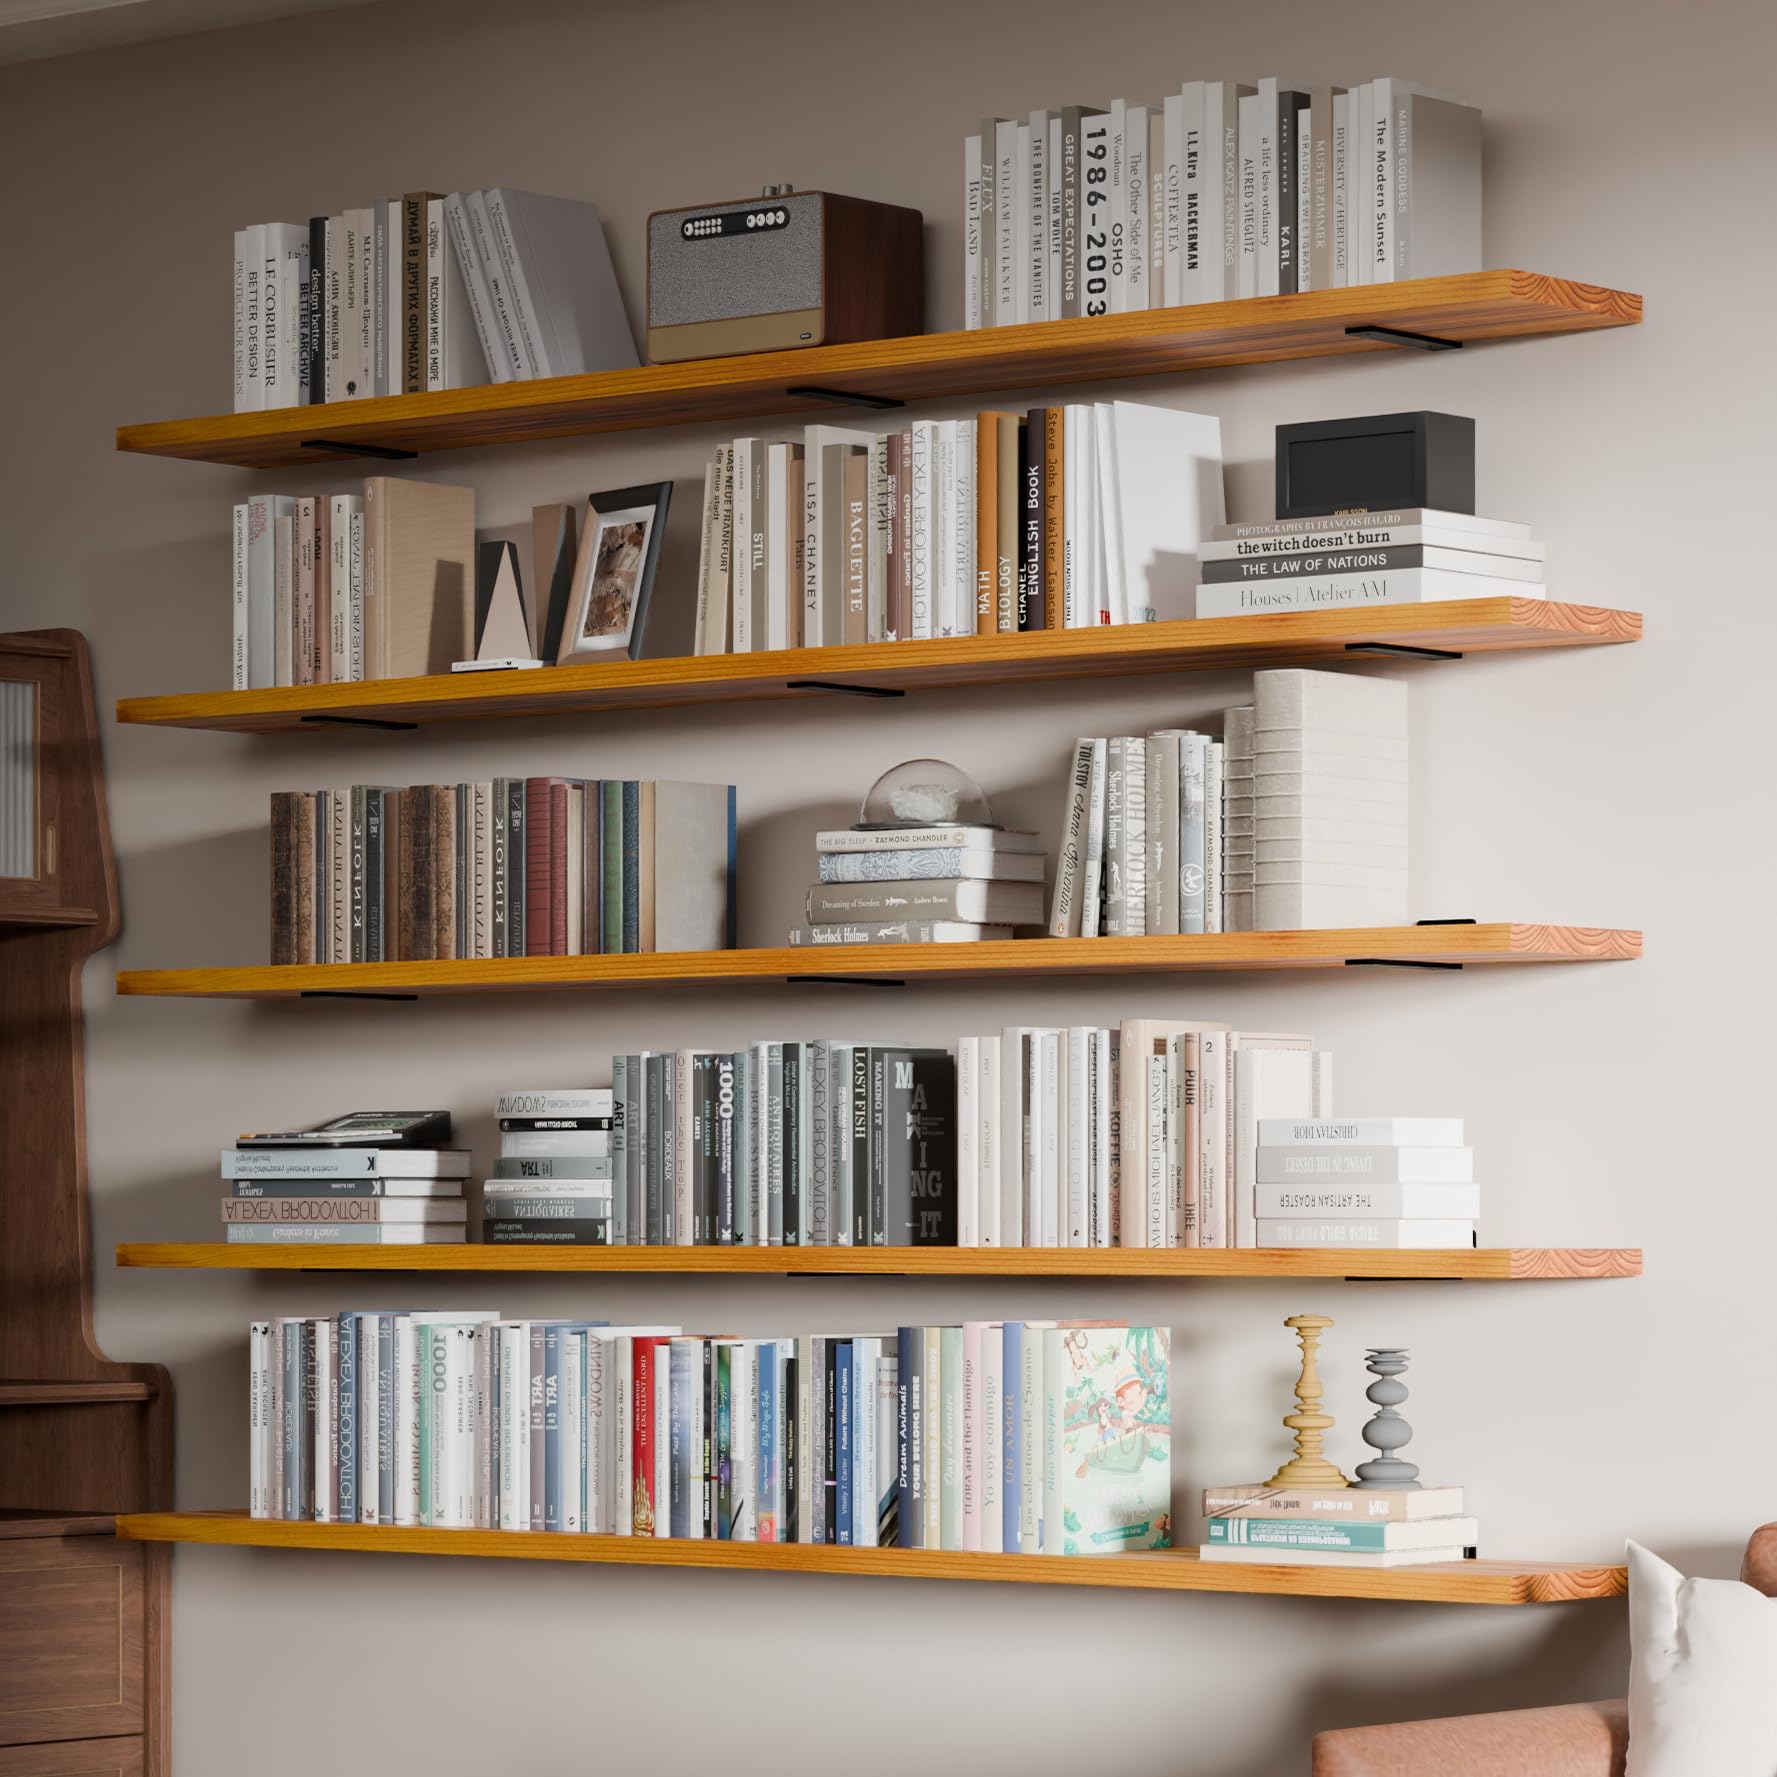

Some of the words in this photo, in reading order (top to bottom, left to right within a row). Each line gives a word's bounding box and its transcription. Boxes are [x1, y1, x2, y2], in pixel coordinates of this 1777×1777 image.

[1032, 138, 1042, 158] THE
[1225, 127, 1234, 159] ALEX
[1376, 117, 1387, 146] The
[1065, 133, 1074, 183] GREAT
[1113, 133, 1122, 187] Woodman
[1130, 152, 1142, 175] The
[1225, 162, 1234, 193] KATZ
[1244, 158, 1254, 198] ALFRED
[1336, 127, 1345, 191] DIVERSITY
[1376, 150, 1387, 207] Modern
[982, 163, 993, 213] FLUX
[1001, 157, 1010, 220] WILLIAM
[1032, 163, 1042, 209] BONFIRE
[1052, 190, 1060, 214] TOM
[1130, 179, 1142, 215] Other
[1315, 140, 1325, 248] MUSTERZIMMER
[1336, 195, 1345, 206] of
[1032, 215, 1042, 227] OF
[1052, 219, 1060, 255] WOLFE
[1086, 128, 1107, 317] 1986-2003
[1130, 219, 1142, 245] Side
[1153, 172, 1163, 268] SCULPTURES
[1225, 197, 1234, 266] PAINTINGS
[1244, 202, 1254, 254] STIEGLITZ
[1336, 210, 1345, 271] HERITAGE
[1376, 212, 1387, 263] Sunset
[1032, 232, 1042, 252] THE
[1065, 188, 1074, 301] EXPECTATIONS
[1112, 222, 1124, 276] OSHO
[1130, 248, 1142, 261] of
[1281, 226, 1290, 270] KARL
[265, 257, 276, 280] LE
[1001, 227, 1010, 304] FAULKNER
[1032, 257, 1042, 307] VANITIES
[1130, 265, 1142, 283] Me
[248, 271, 258, 321] BETTER
[300, 282, 309, 328] BETTER
[310, 269, 321, 310] design
[429, 276, 438, 324] РАССКАЖИ
[248, 325, 258, 378] DESIGN
[265, 284, 276, 388] CORBUSIER
[310, 313, 321, 361] better...
[429, 327, 438, 346] МНЕ
[300, 332, 309, 389] ARCHVIZ
[429, 359, 438, 382] МОРЕ
[1048, 412, 1057, 450] Steve
[715, 449, 724, 464] die
[726, 449, 734, 473] DAS
[1048, 458, 1057, 486] Jobs
[713, 467, 721, 493] neue
[724, 476, 733, 505] NEUE
[712, 495, 721, 521] stadt
[807, 482, 816, 524] LISA
[1048, 495, 1057, 509] by
[719, 509, 731, 574] FRANKFURT
[1048, 517, 1057, 562] Walter
[1237, 521, 1303, 536] PHOTOGRAPHS
[1304, 520, 1316, 531] BY
[1317, 517, 1361, 531] FRANÇOIS
[1363, 513, 1401, 525] HALARD
[1237, 541, 1260, 554] the
[1262, 537, 1301, 553] witch
[1302, 533, 1354, 550] doesn't
[1357, 530, 1391, 544] burn
[753, 532, 764, 571] STILL
[849, 500, 863, 613] BAGUETTE
[1027, 519, 1039, 596] ENGLISH
[1241, 562, 1268, 577] THE
[1273, 560, 1300, 573] LAW
[1304, 558, 1322, 571] OF
[1327, 552, 1387, 569] NATIONS
[807, 534, 816, 611] CHANEY
[978, 570, 991, 614] MATH
[999, 556, 1011, 630] BIOLOGY
[1240, 588, 1292, 607] Houses
[1305, 584, 1356, 603] Atelier
[1360, 579, 1387, 598] AM
[1018, 563, 1026, 624] CHANEL
[1048, 570, 1057, 630] Isaacson
[1075, 745, 1093, 789] TOLSTOY
[1109, 771, 1121, 811] Sherlock
[1070, 793, 1085, 837] Anna
[1109, 815, 1121, 849] Holmes
[875, 834, 910, 844] RAYMOND
[912, 833, 948, 843] CHANDLER
[1059, 843, 1079, 915] Karenina
[812, 929, 842, 944] Sherlock
[843, 927, 869, 942] Holmes
[1204, 1042, 1213, 1052] 2
[720, 1061, 733, 1119] 1000
[813, 1045, 826, 1113] ALEXEY
[855, 1051, 866, 1096] LOST
[874, 1061, 882, 1110] MAKING
[1185, 1069, 1195, 1105] PUUR
[614, 1100, 624, 1130] ART
[628, 1100, 639, 1130] ART
[855, 1100, 866, 1139] FISH
[874, 1113, 882, 1126] IT
[1293, 1125, 1314, 1139] DIOR
[1316, 1125, 1358, 1139] CHRISTIAN
[664, 1130, 672, 1180] BORDEAUX
[772, 1096, 781, 1194] ANTIQUAIRES
[1110, 1110, 1120, 1168] KOFFIE
[813, 1118, 826, 1232] BRODOVITCH
[1185, 1201, 1195, 1230] THEE
[1279, 1194, 1316, 1207] ROASTER
[1318, 1194, 1353, 1207] ARTISAN
[1356, 1194, 1372, 1207] THE
[1023, 1348, 1034, 1407] Susana
[899, 1385, 908, 1440] Animals
[985, 1375, 996, 1446] conmigo
[1006, 1393, 1015, 1451] AMOR
[1023, 1410, 1034, 1427] de
[899, 1442, 908, 1489] Dream
[985, 1451, 996, 1480] voy
[1006, 1458, 1015, 1484] UN
[1023, 1432, 1034, 1504] calcetines
[985, 1486, 996, 1508] Yo
[1023, 1507, 1034, 1537] Los
